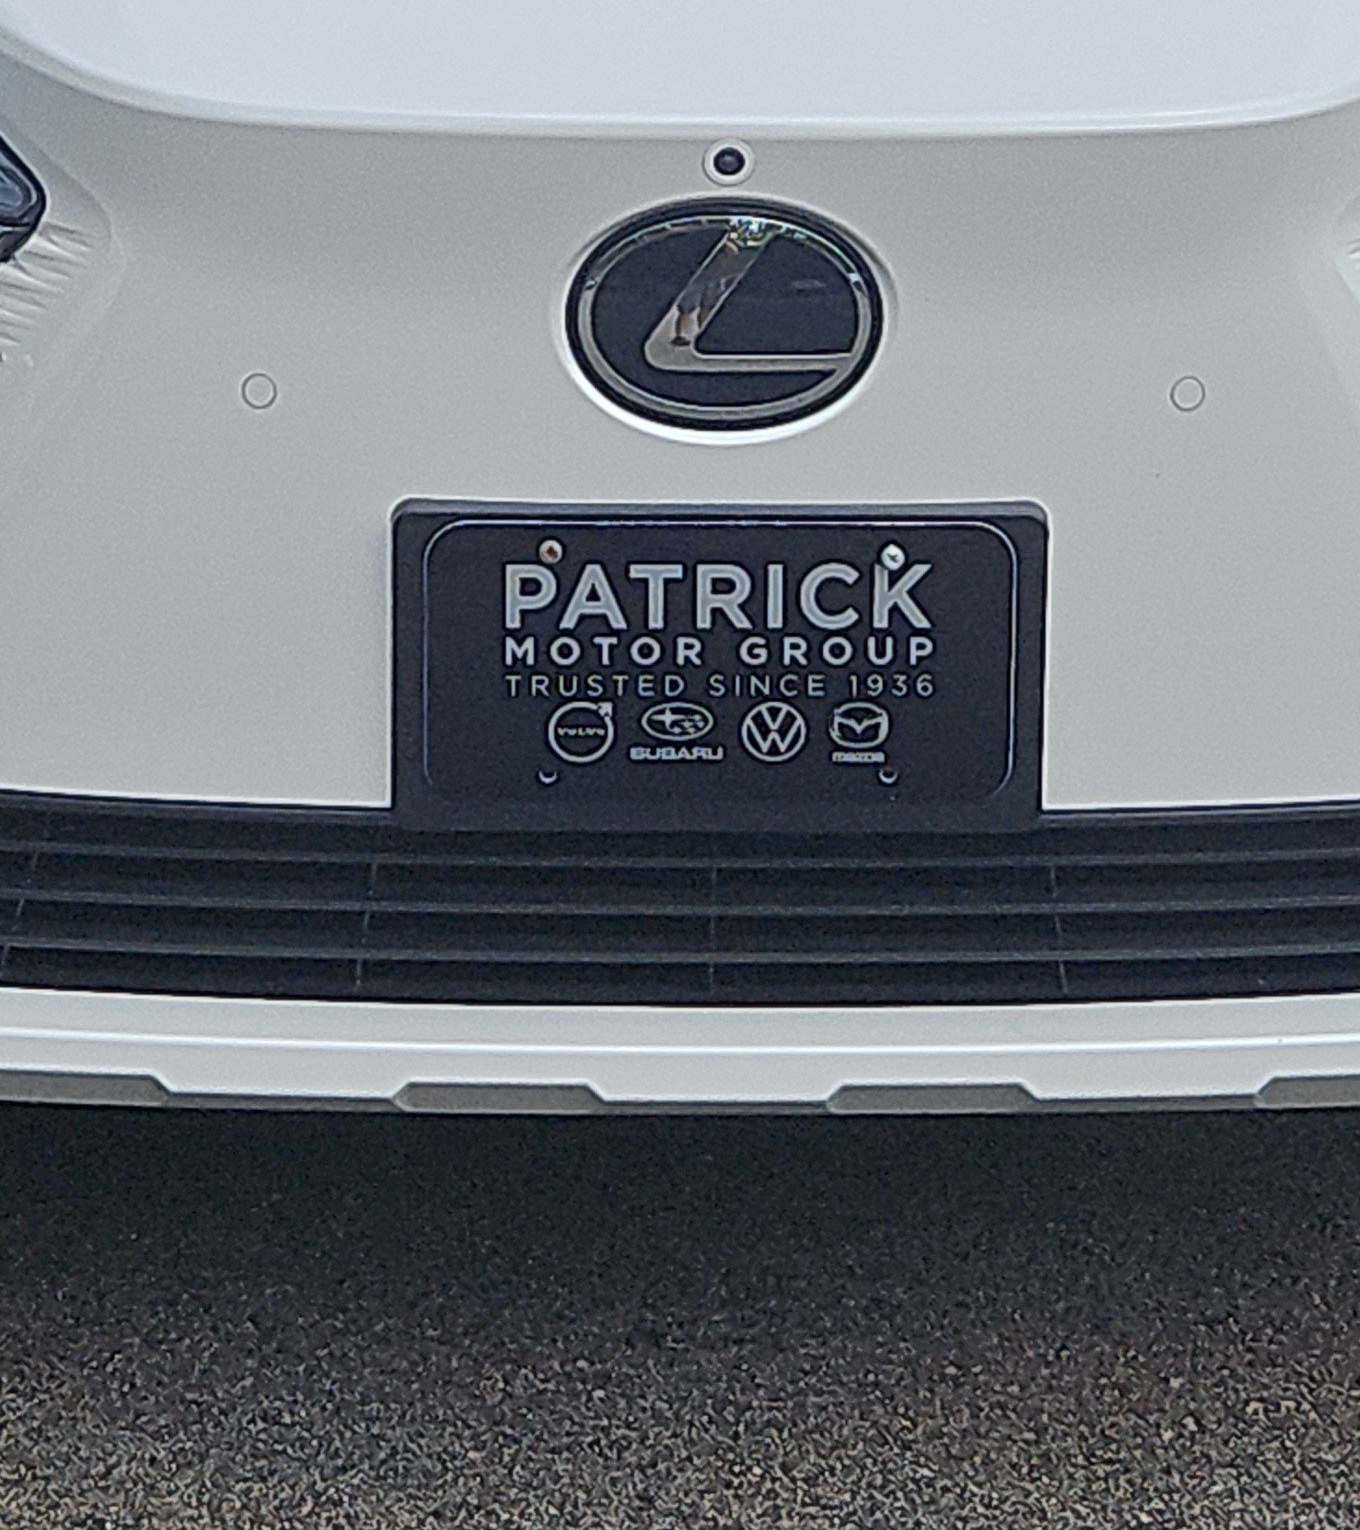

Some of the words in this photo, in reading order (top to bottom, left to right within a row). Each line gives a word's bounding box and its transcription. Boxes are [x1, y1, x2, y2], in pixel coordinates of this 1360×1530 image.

[504, 563, 934, 629] PATRICK
[505, 637, 703, 666] MOTOR
[740, 637, 935, 666] GROUP
[505, 675, 685, 697] TRUSTED
[709, 675, 826, 697] SINCE
[850, 675, 934, 697] 1936
[557, 726, 606, 737] VOLVO
[630, 747, 724, 761] SUBARU
